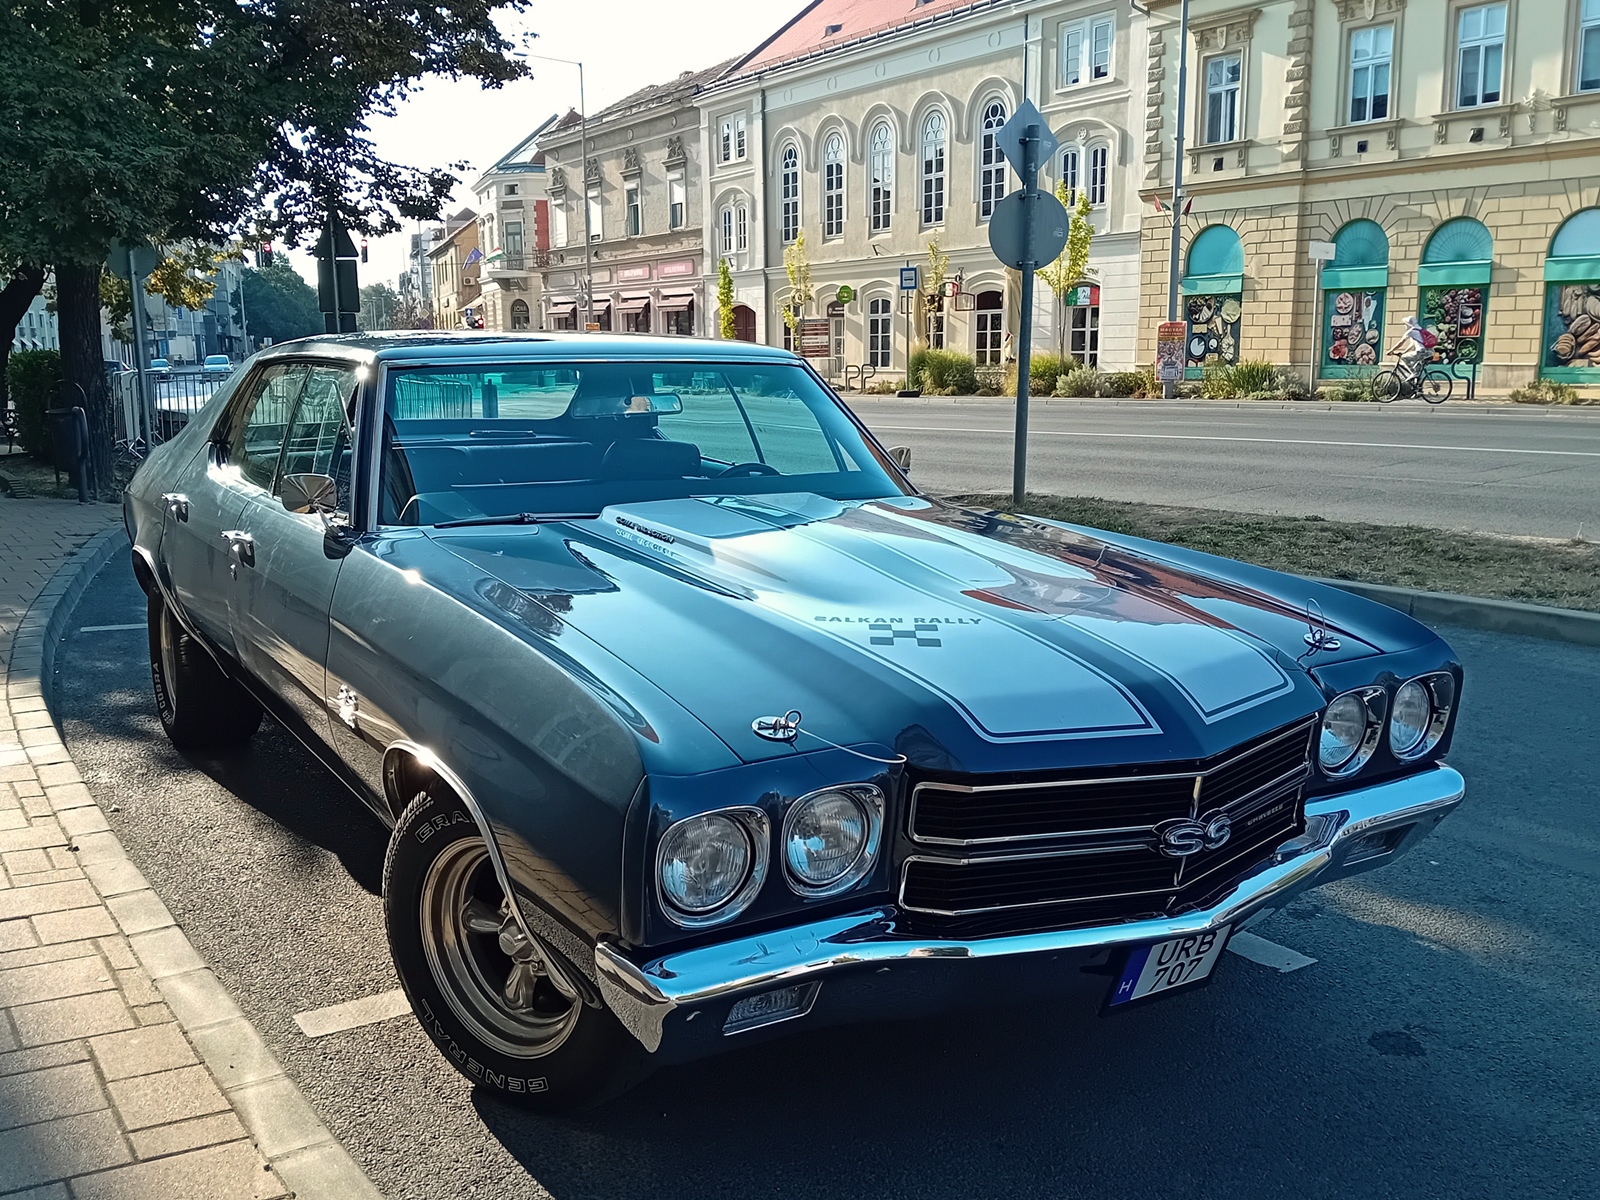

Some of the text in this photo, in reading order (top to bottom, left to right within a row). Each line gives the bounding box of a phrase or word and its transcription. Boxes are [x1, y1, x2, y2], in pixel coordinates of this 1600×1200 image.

[814, 615, 982, 625] BALKAN RALLY
[152, 662, 166, 709] COBRA
[414, 810, 476, 844] GRA
[1160, 813, 1231, 858] SS
[1157, 931, 1218, 967] URB
[1118, 979, 1133, 995] H
[1148, 956, 1204, 993] 707
[421, 998, 549, 1093] GENERAL
